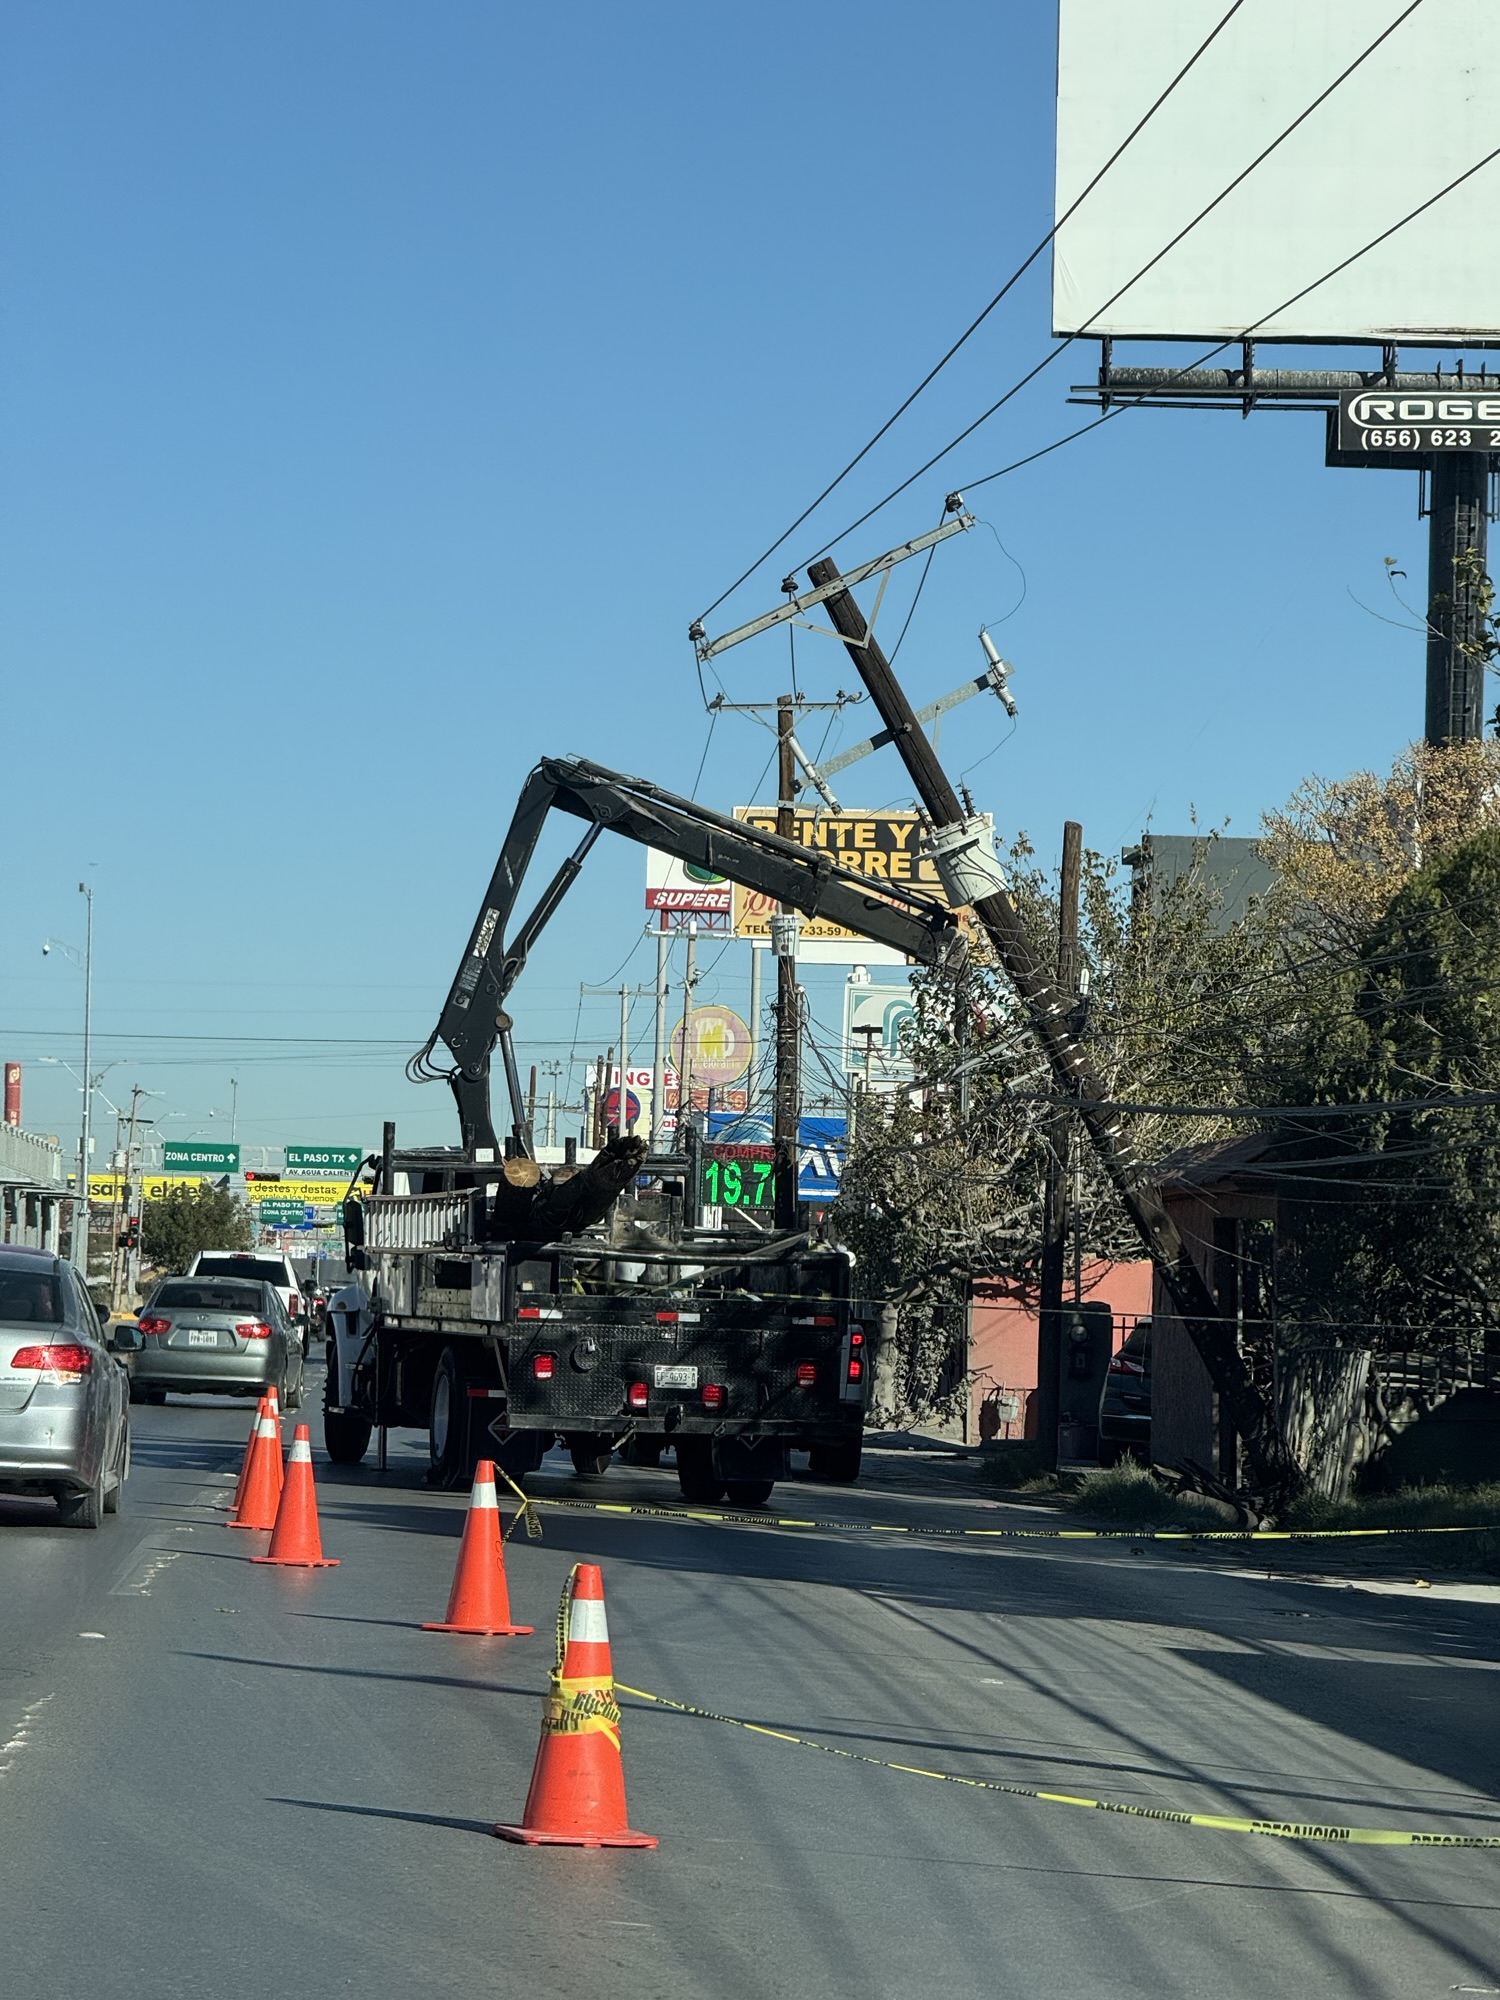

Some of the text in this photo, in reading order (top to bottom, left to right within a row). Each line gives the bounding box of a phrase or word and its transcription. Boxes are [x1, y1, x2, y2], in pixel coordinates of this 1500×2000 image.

[1361, 429, 1421, 451] (656)
[1430, 430, 1472, 446] 623
[887, 823, 915, 849] Y
[165, 1151, 225, 1163] ZONA CENTRO
[289, 1153, 345, 1163] EL PASO TX
[323, 1169, 359, 1177] CALIENT
[705, 1160, 776, 1205] 19.7
